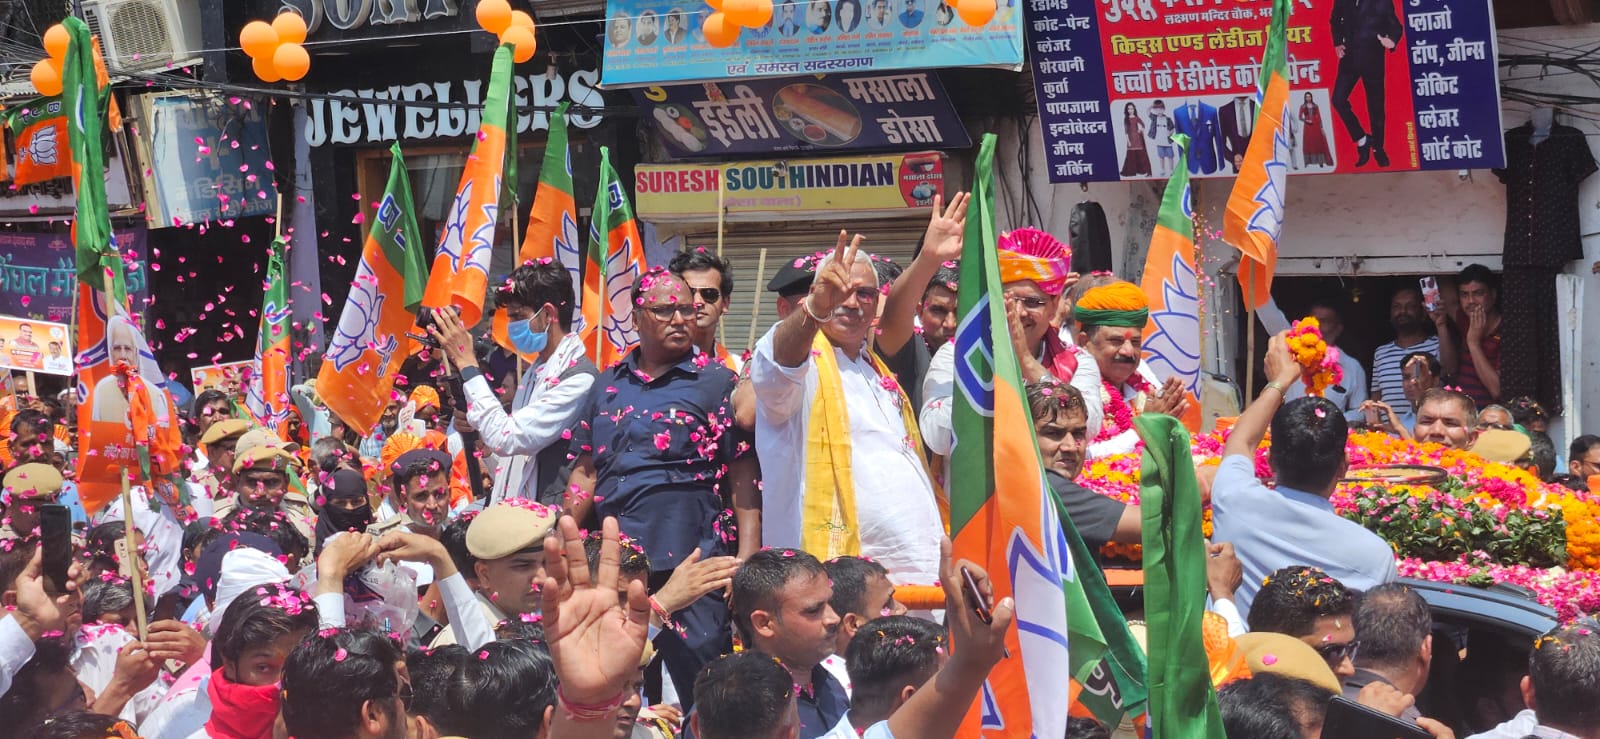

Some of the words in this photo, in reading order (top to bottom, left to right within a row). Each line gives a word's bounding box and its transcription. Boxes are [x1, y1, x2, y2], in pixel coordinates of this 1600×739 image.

[1033, 14, 1090, 32] कोट-पेन्ट
[1408, 5, 1452, 32] प्लाजो
[1036, 37, 1071, 53] ब्लेजर
[1111, 34, 1163, 58] किड्स
[1166, 33, 1204, 52] एण्ड
[1207, 27, 1263, 50] लेडीज
[1411, 40, 1444, 67] टॉप,
[1446, 37, 1485, 62] जीन्स
[727, 61, 746, 75] एवं
[755, 60, 800, 73] समस्त
[803, 56, 874, 72] सदस्यगण
[1039, 56, 1085, 74] शेरवानी
[1111, 62, 1152, 94] बच्चों
[1154, 61, 1173, 90] के
[1176, 58, 1231, 91] रेडीमेड
[1233, 54, 1264, 88] को
[843, 74, 936, 104] मसाला
[1042, 77, 1069, 98] कुर्ता
[1414, 73, 1459, 97] जेकिट
[1045, 101, 1100, 115] पायजामा
[877, 109, 943, 144] डोसा
[1052, 141, 1084, 156] जीन्स
[1421, 136, 1450, 161] शोर्ट
[1452, 134, 1482, 159] कोट
[1055, 160, 1093, 176] जर्किन
[636, 169, 720, 193] SURESH
